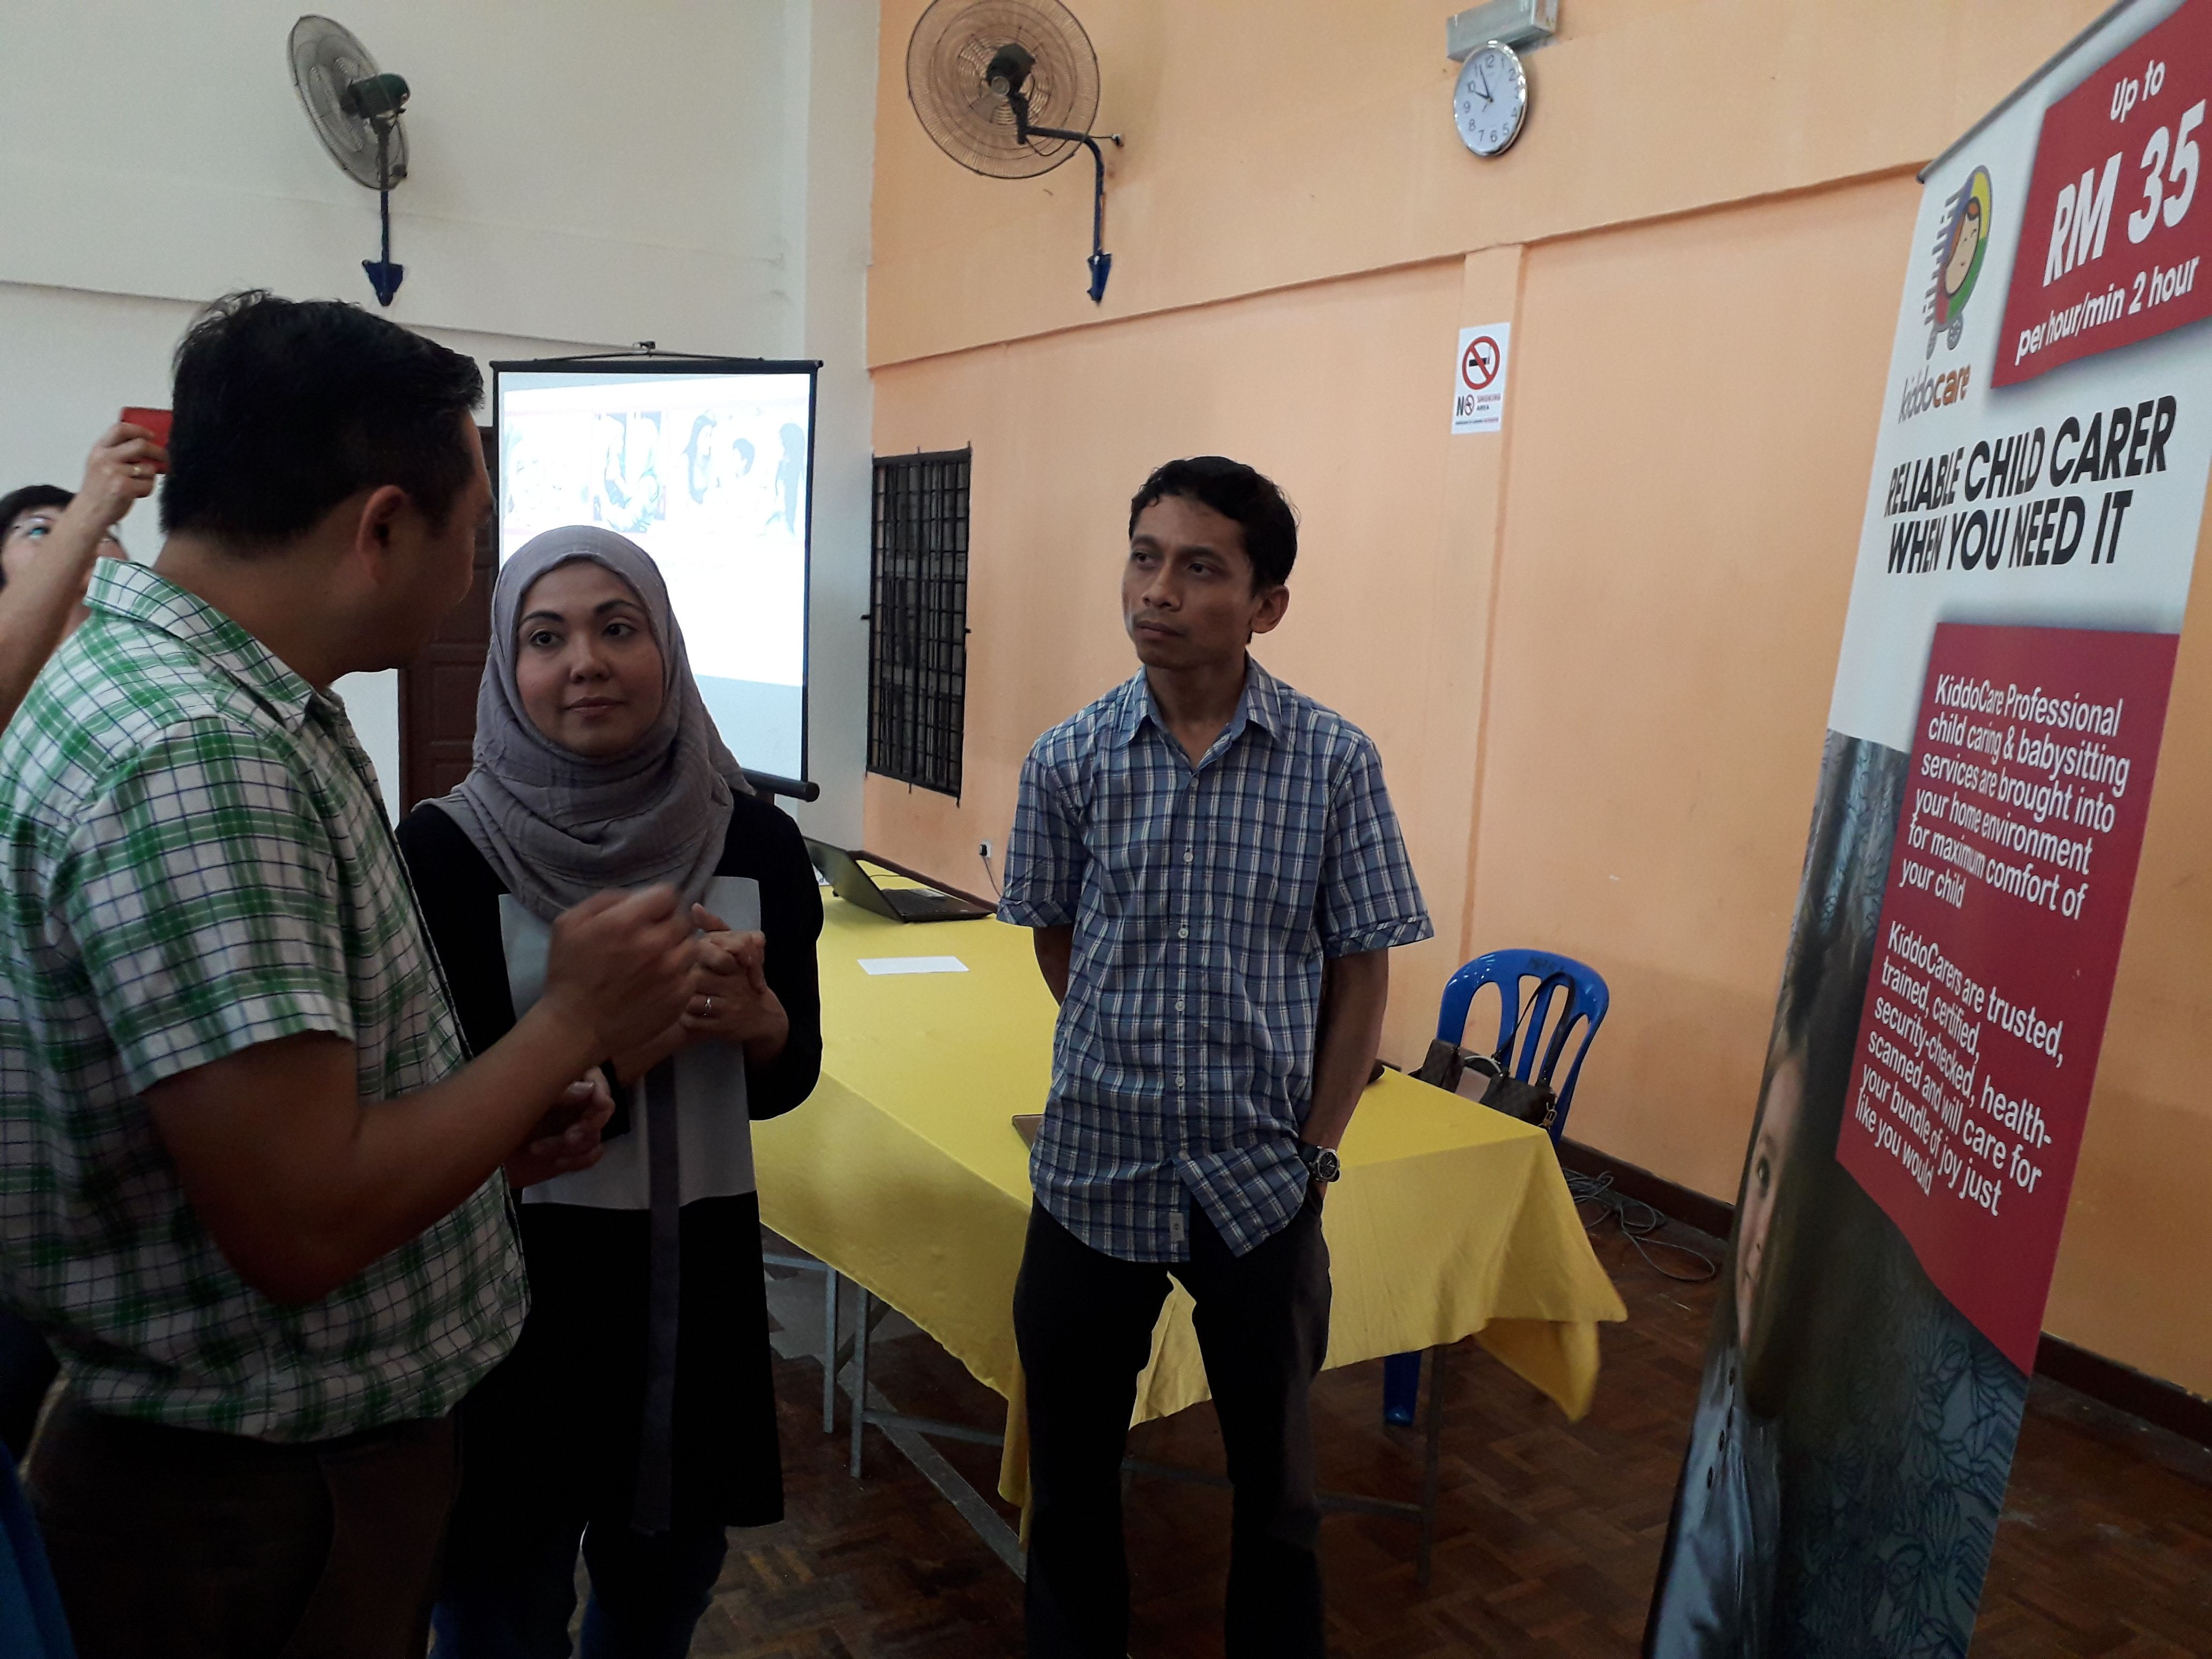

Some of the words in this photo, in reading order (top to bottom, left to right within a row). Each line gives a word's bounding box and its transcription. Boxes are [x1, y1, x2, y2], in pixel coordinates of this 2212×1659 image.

[1464, 101, 1470, 113] 9
[1509, 69, 1515, 81] 2
[2110, 78, 2138, 123] Up
[2141, 60, 2165, 100] to
[1469, 119, 1476, 131] 8
[1478, 130, 1484, 141] 7
[1490, 130, 1497, 143] 6
[1503, 123, 1509, 135] 5
[2043, 151, 2123, 287] RM
[2127, 99, 2206, 244] 35
[2014, 320, 2045, 365] per
[2128, 271, 2145, 313] 2
[2147, 256, 2199, 308] hour
[1456, 394, 1475, 415] NO
[1884, 446, 1964, 518] RELIABLE
[1964, 427, 2045, 502] CHILD
[2049, 395, 2177, 488] CARER
[1887, 515, 1948, 574] WHEN
[1946, 507, 2009, 571] YOU
[2008, 496, 2085, 569] NEED
[2090, 490, 2133, 565] IT
[1934, 674, 2004, 715] KiddoCare
[2004, 683, 2124, 737] Professional
[1920, 752, 1979, 790] services
[1979, 769, 1998, 797] are
[1998, 767, 2073, 823] brought
[2074, 787, 2116, 833] into
[1929, 711, 1966, 746] child
[1967, 721, 2002, 765] caring
[2002, 725, 2015, 760] &
[2016, 733, 2131, 797] babysitting
[1908, 813, 1931, 849] for
[1930, 833, 1986, 879] maximum
[1986, 858, 2060, 911] comfort
[2061, 883, 2089, 920] of
[1915, 788, 1949, 818] your
[1949, 791, 1982, 834] home
[1982, 811, 2093, 875] environment
[1899, 858, 1934, 890] your
[1935, 870, 1966, 910] child
[1881, 955, 1930, 1019] trained,
[1932, 996, 1981, 1064] certified,
[1887, 921, 1963, 998] KiddoCarers
[1962, 977, 1985, 1013] are
[1986, 986, 2064, 1068] trusted,
[1867, 1030, 1923, 1090] scanned
[1923, 1073, 1943, 1112] and
[1941, 1094, 1963, 1135] will
[1963, 1118, 2007, 1169] care
[2009, 1144, 2043, 1193] for
[1874, 996, 1976, 1108] security-checked,
[1981, 1074, 2052, 1148] health-
[1855, 1086, 1877, 1133] like
[1874, 1118, 1900, 1156] you
[1902, 1140, 1934, 1197] would
[1859, 1064, 1892, 1102] your
[1890, 1081, 1931, 1145] bundle
[1929, 1128, 1942, 1159] of
[1938, 1139, 1962, 1189] joy
[1959, 1158, 2002, 1217] just
